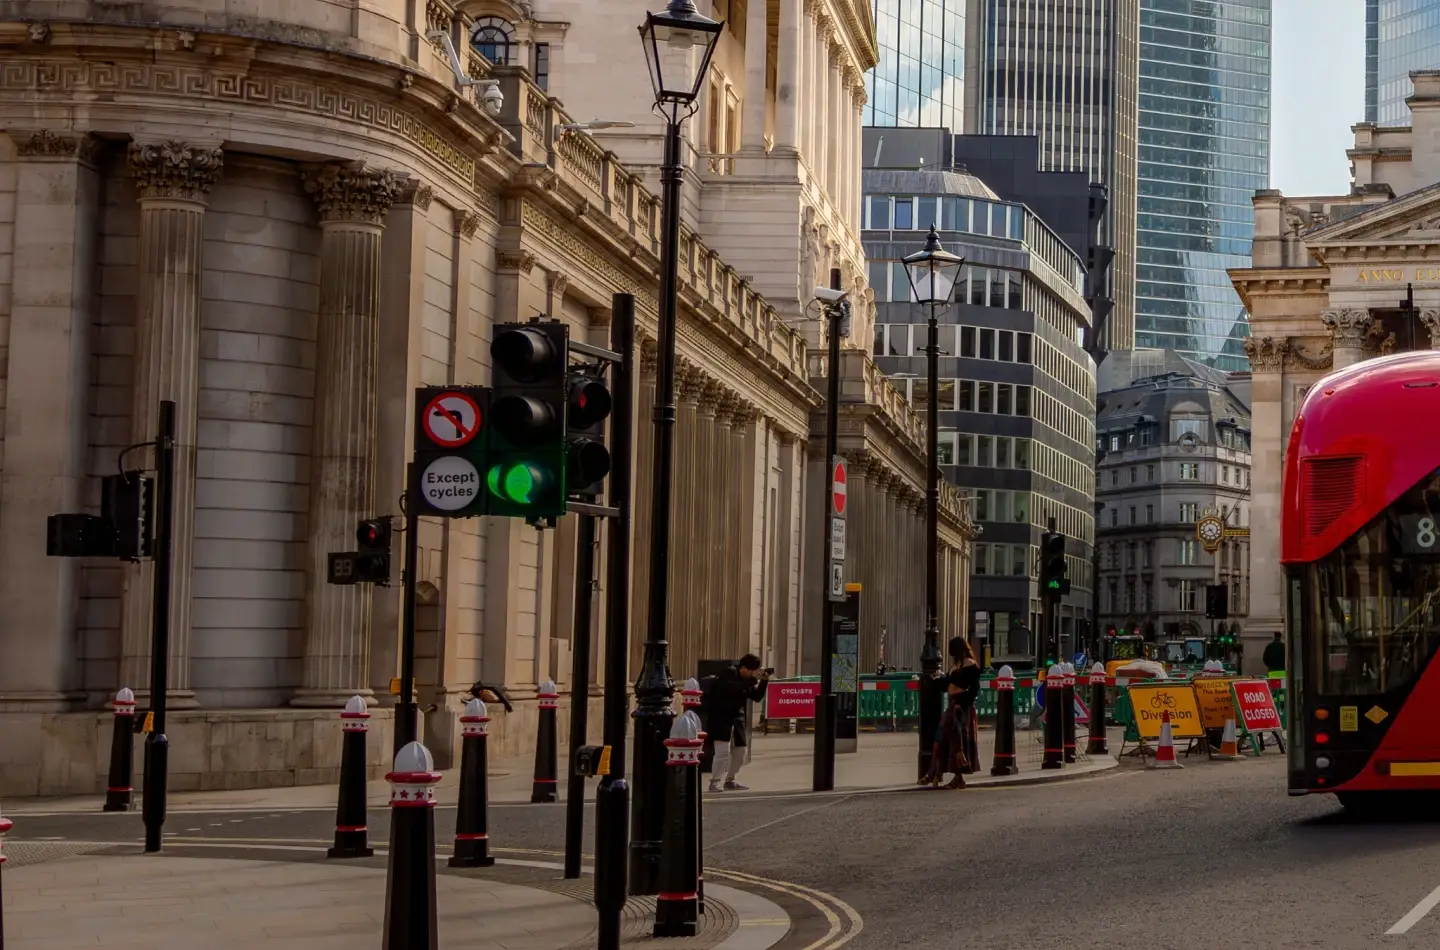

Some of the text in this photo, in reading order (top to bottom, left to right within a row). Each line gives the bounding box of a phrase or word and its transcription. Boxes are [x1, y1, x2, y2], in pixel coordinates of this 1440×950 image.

[1356, 268, 1405, 282] ANNO
[427, 472, 475, 484] Except
[429, 486, 473, 499] cycles
[1417, 517, 1436, 548] 8
[1243, 691, 1266, 704] ROAD
[1140, 709, 1193, 721] Divesion
[1244, 708, 1276, 721] CLOSED
